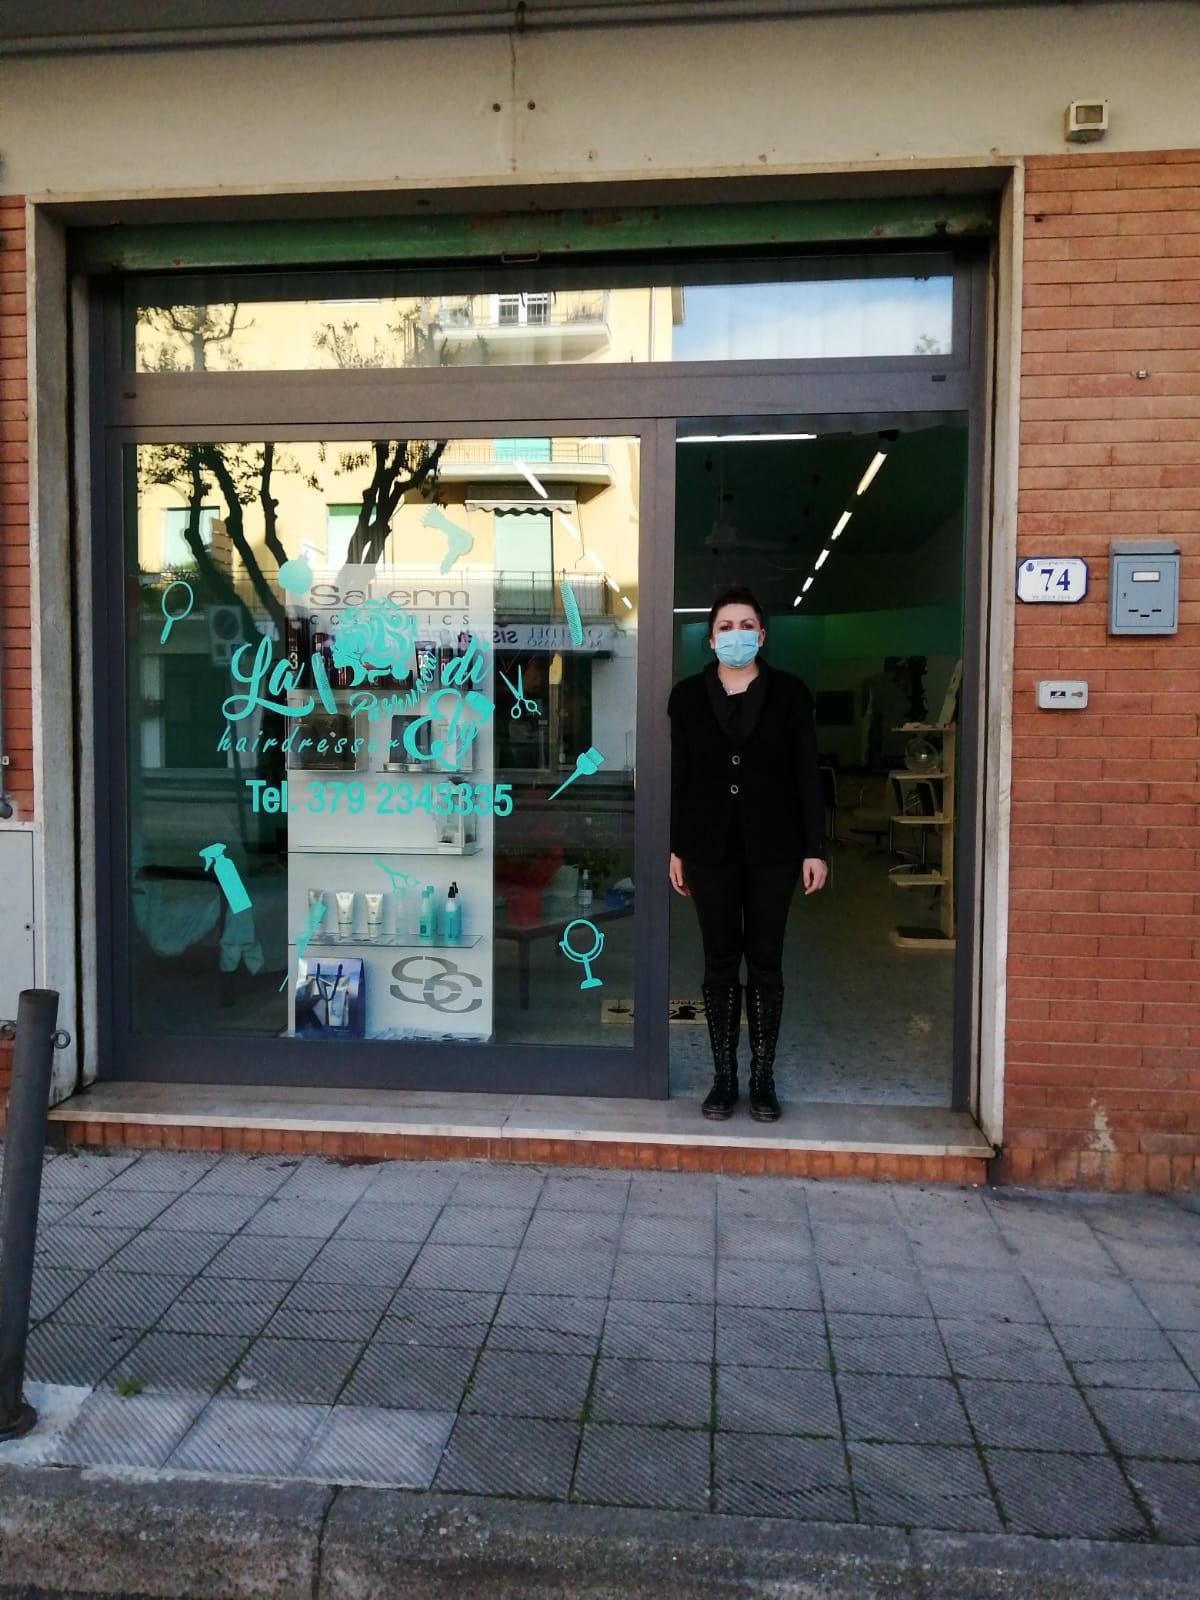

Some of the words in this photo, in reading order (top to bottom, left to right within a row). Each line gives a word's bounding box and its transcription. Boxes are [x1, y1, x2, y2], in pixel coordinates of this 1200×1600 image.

[309, 583, 470, 607] Salerm
[1041, 569, 1071, 592] 74
[222, 636, 315, 721] La
[441, 633, 492, 686] di
[217, 724, 400, 755] hairdresser
[403, 688, 480, 771] Ely
[246, 779, 297, 813] Tel.
[306, 781, 366, 814] 379
[375, 783, 513, 817] 2343335
